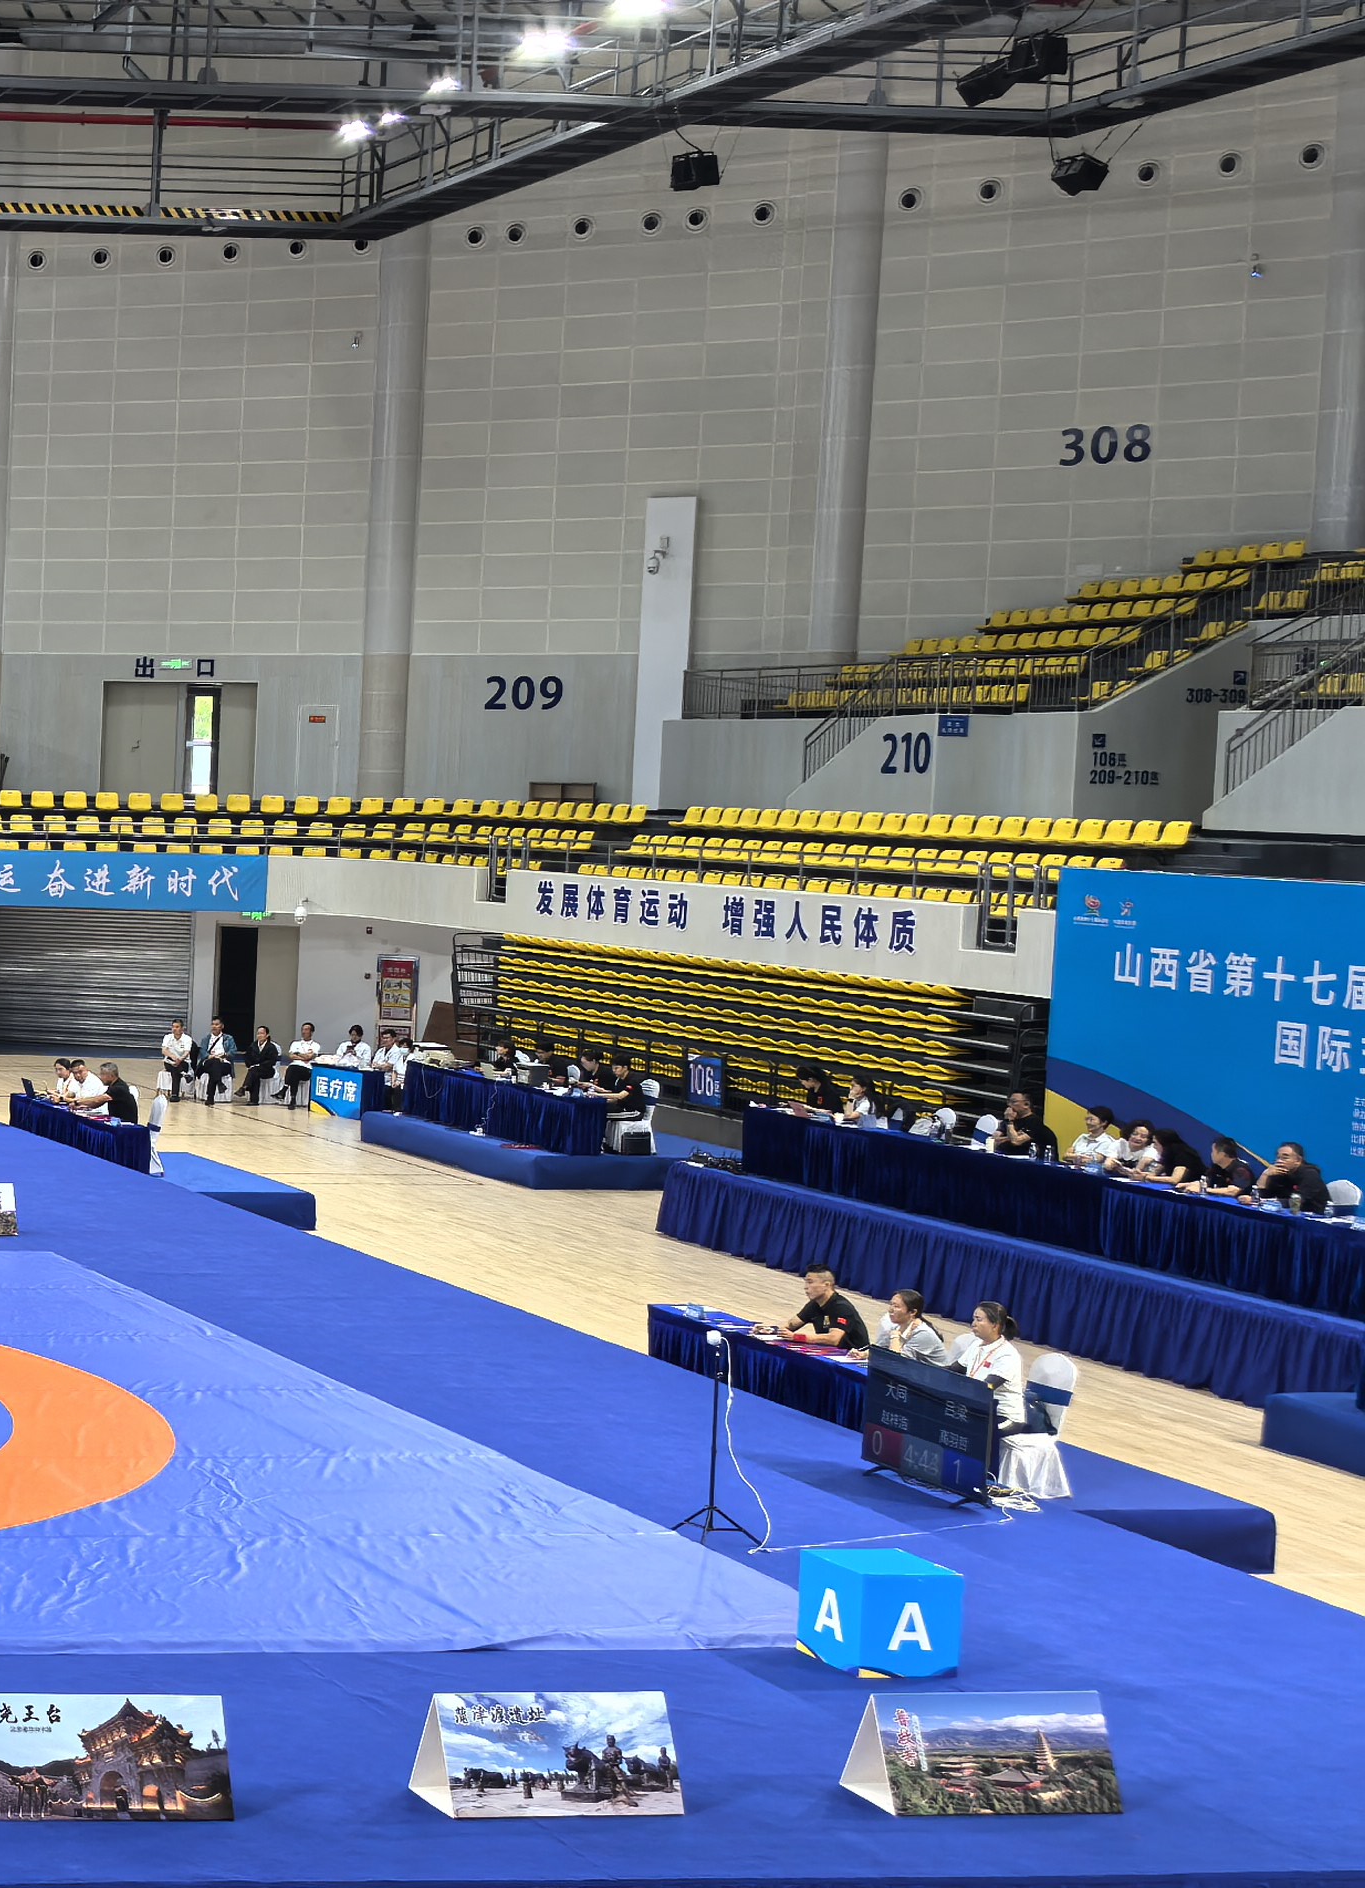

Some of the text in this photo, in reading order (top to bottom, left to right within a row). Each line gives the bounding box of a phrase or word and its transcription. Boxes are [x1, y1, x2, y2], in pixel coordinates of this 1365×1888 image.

[1059, 424, 1152, 467] 308
[483, 674, 565, 711] 209
[880, 732, 933, 775] 210
[40, 858, 242, 902] 奋进新时代
[535, 879, 919, 955] 发展体育运动 增强人民体质
[315, 1075, 358, 1103] 医疗席
[885, 1380, 909, 1403] 大同
[871, 1430, 884, 1456] 0
[952, 1458, 961, 1485] 1
[812, 1587, 844, 1644] A
[886, 1601, 933, 1653] A
